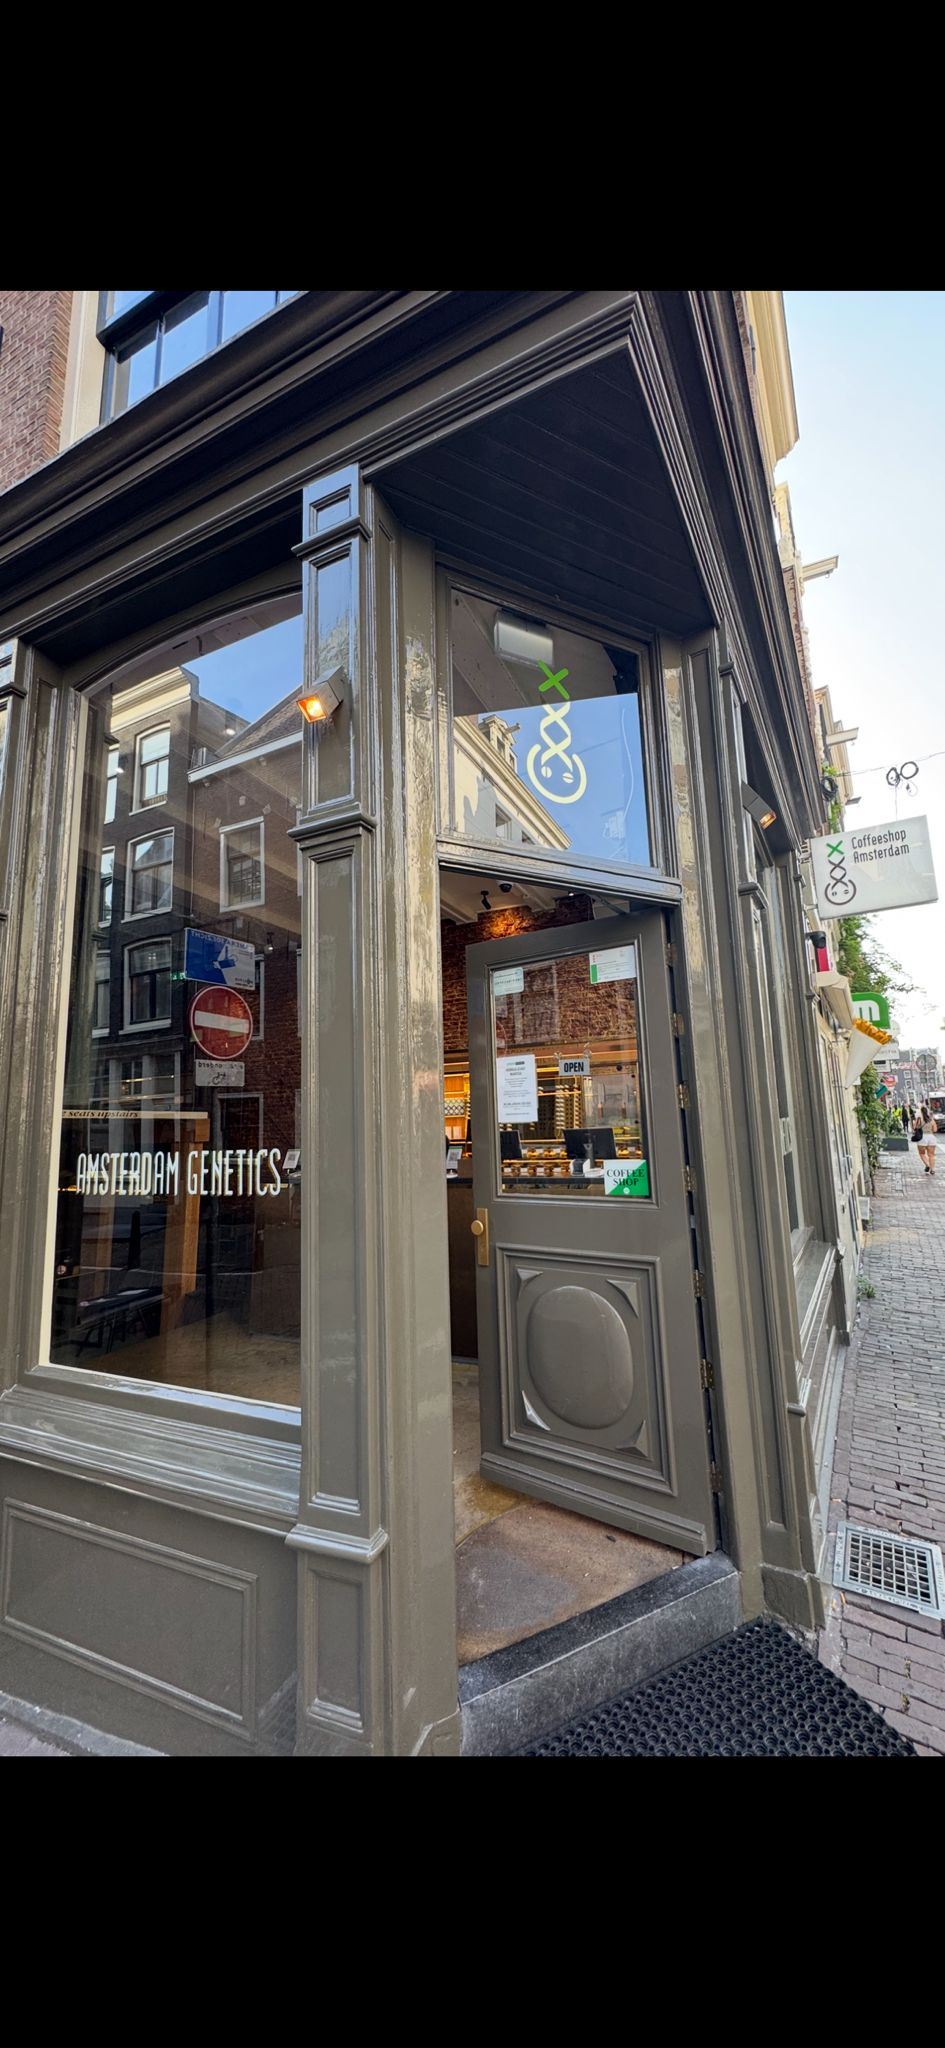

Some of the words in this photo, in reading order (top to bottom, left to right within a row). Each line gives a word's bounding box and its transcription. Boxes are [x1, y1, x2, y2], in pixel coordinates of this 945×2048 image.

[851, 829, 907, 850] Coffeeshop
[853, 844, 910, 864] Amsterdam
[563, 1061, 584, 1073] OPEN
[97, 1110, 138, 1119] upstairs
[76, 1151, 180, 1196] AMSTERDAM
[187, 1148, 282, 1197] GENETICS
[606, 1168, 645, 1178] COFFEE
[612, 1178, 639, 1187] SHOP
